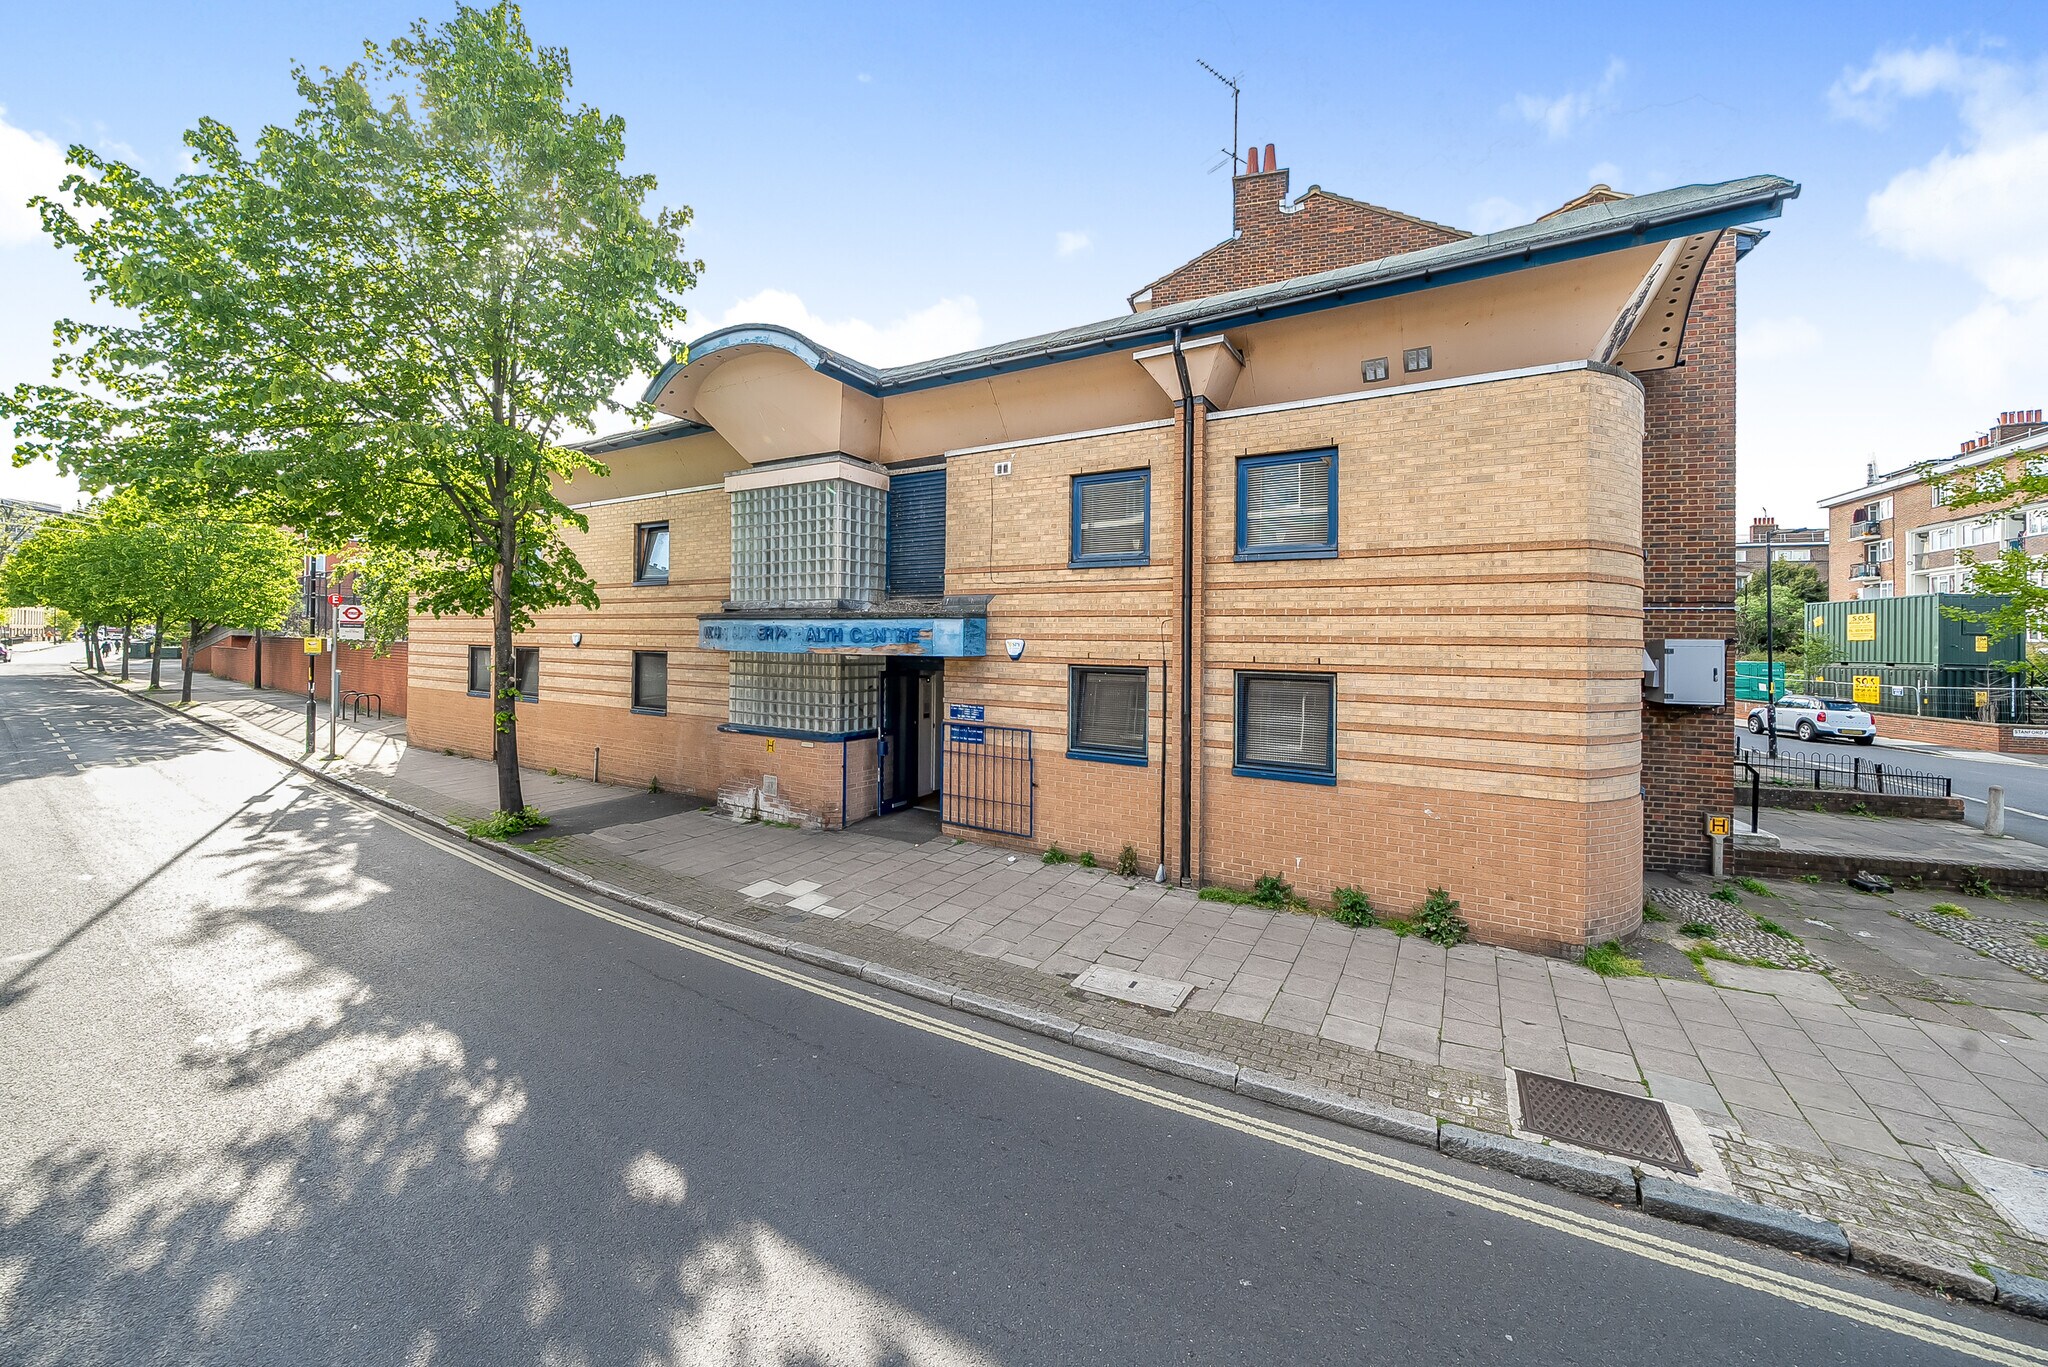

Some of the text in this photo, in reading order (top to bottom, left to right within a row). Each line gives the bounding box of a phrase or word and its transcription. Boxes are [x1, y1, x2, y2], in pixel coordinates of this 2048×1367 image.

[332, 595, 340, 604] E
[766, 739, 776, 752] H
[1712, 818, 1725, 832] H
